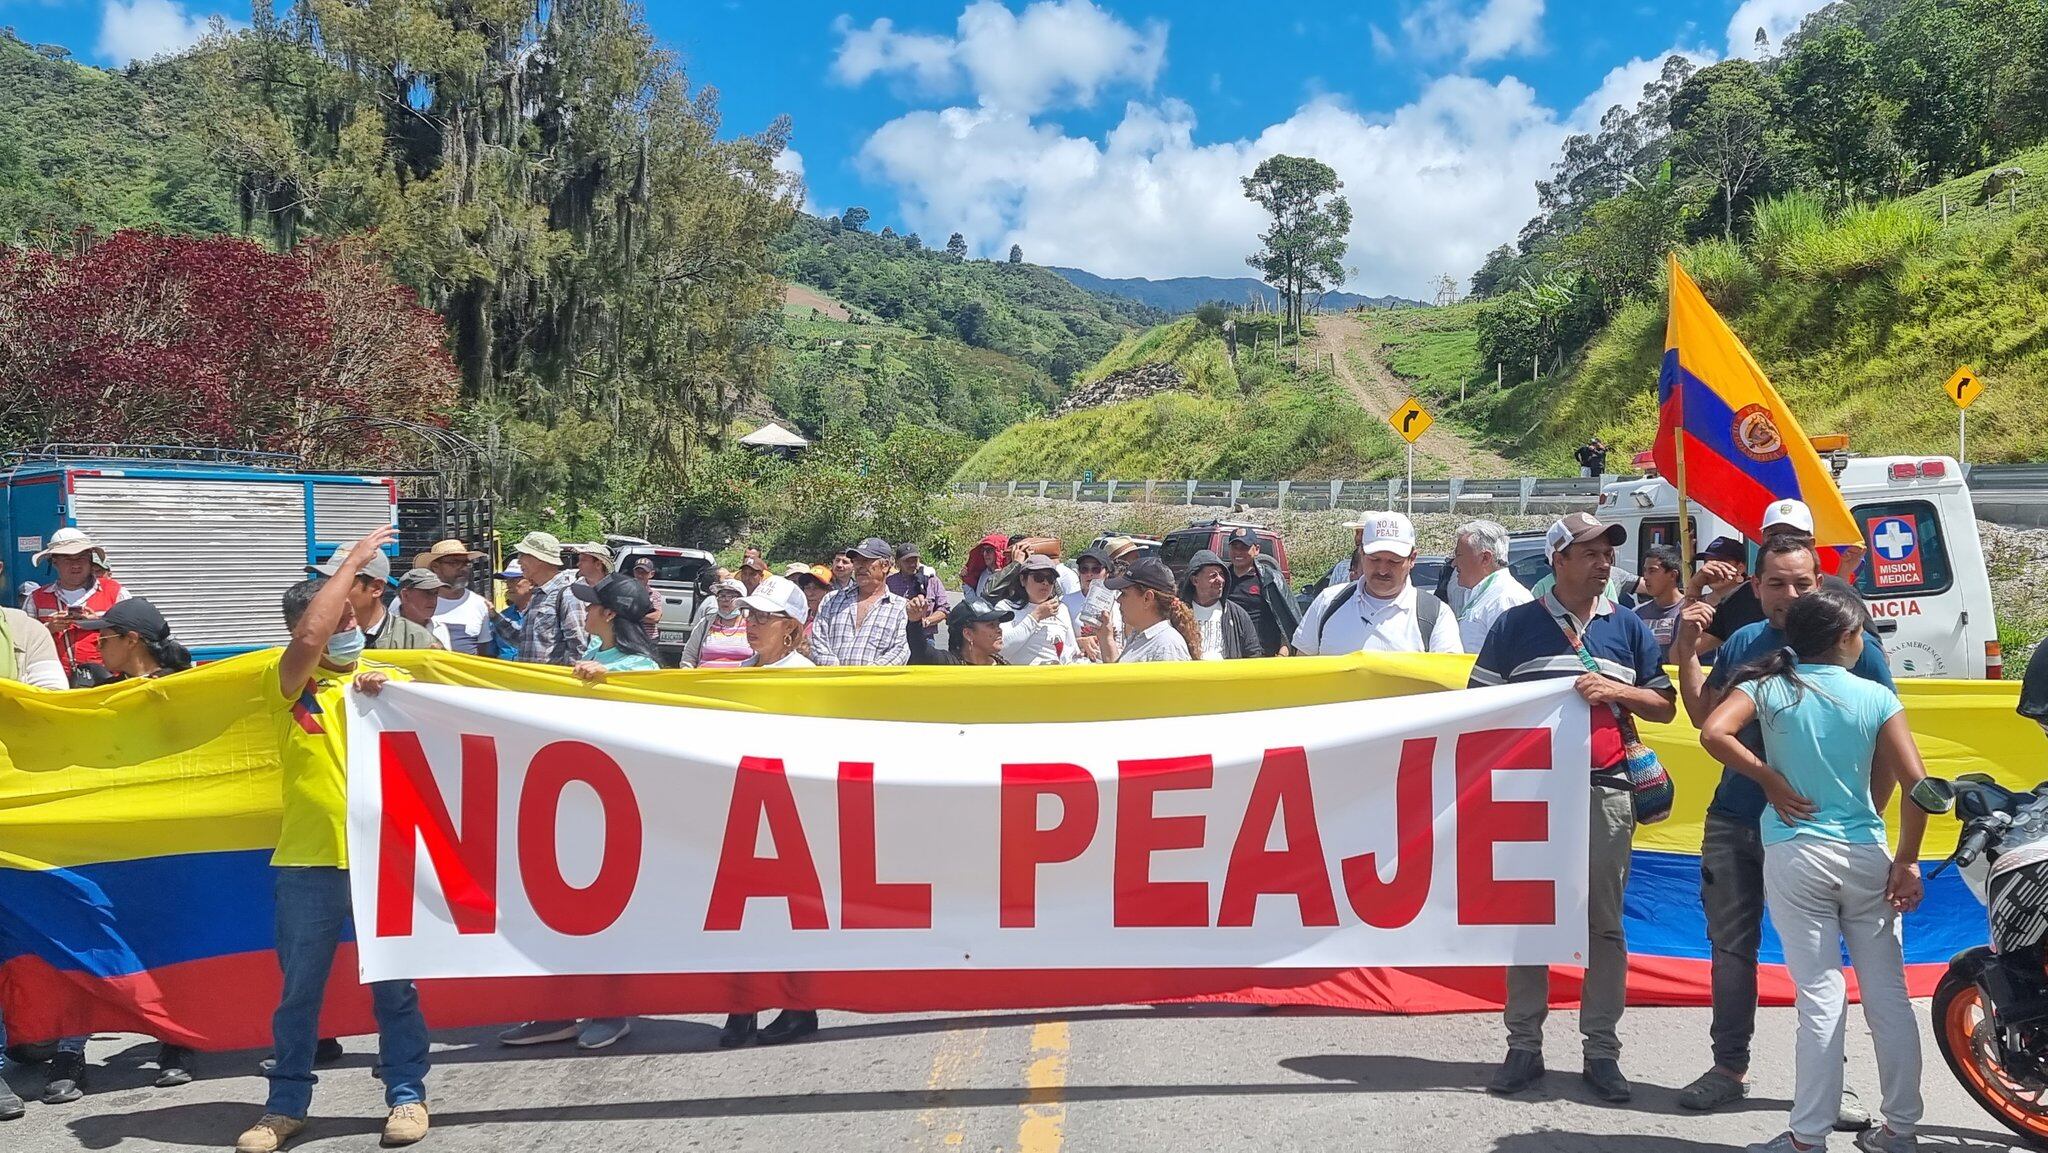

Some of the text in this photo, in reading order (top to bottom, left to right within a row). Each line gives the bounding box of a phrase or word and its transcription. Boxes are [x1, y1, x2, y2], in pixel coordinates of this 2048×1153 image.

[1376, 520, 1387, 528] NO
[1376, 529, 1399, 537] PEAJE
[1879, 563, 1916, 574] MISION
[1879, 573, 1920, 584] MEDICA
[1871, 600, 1921, 618] NCIA
[377, 727, 1556, 938] NO AL PEAJE
